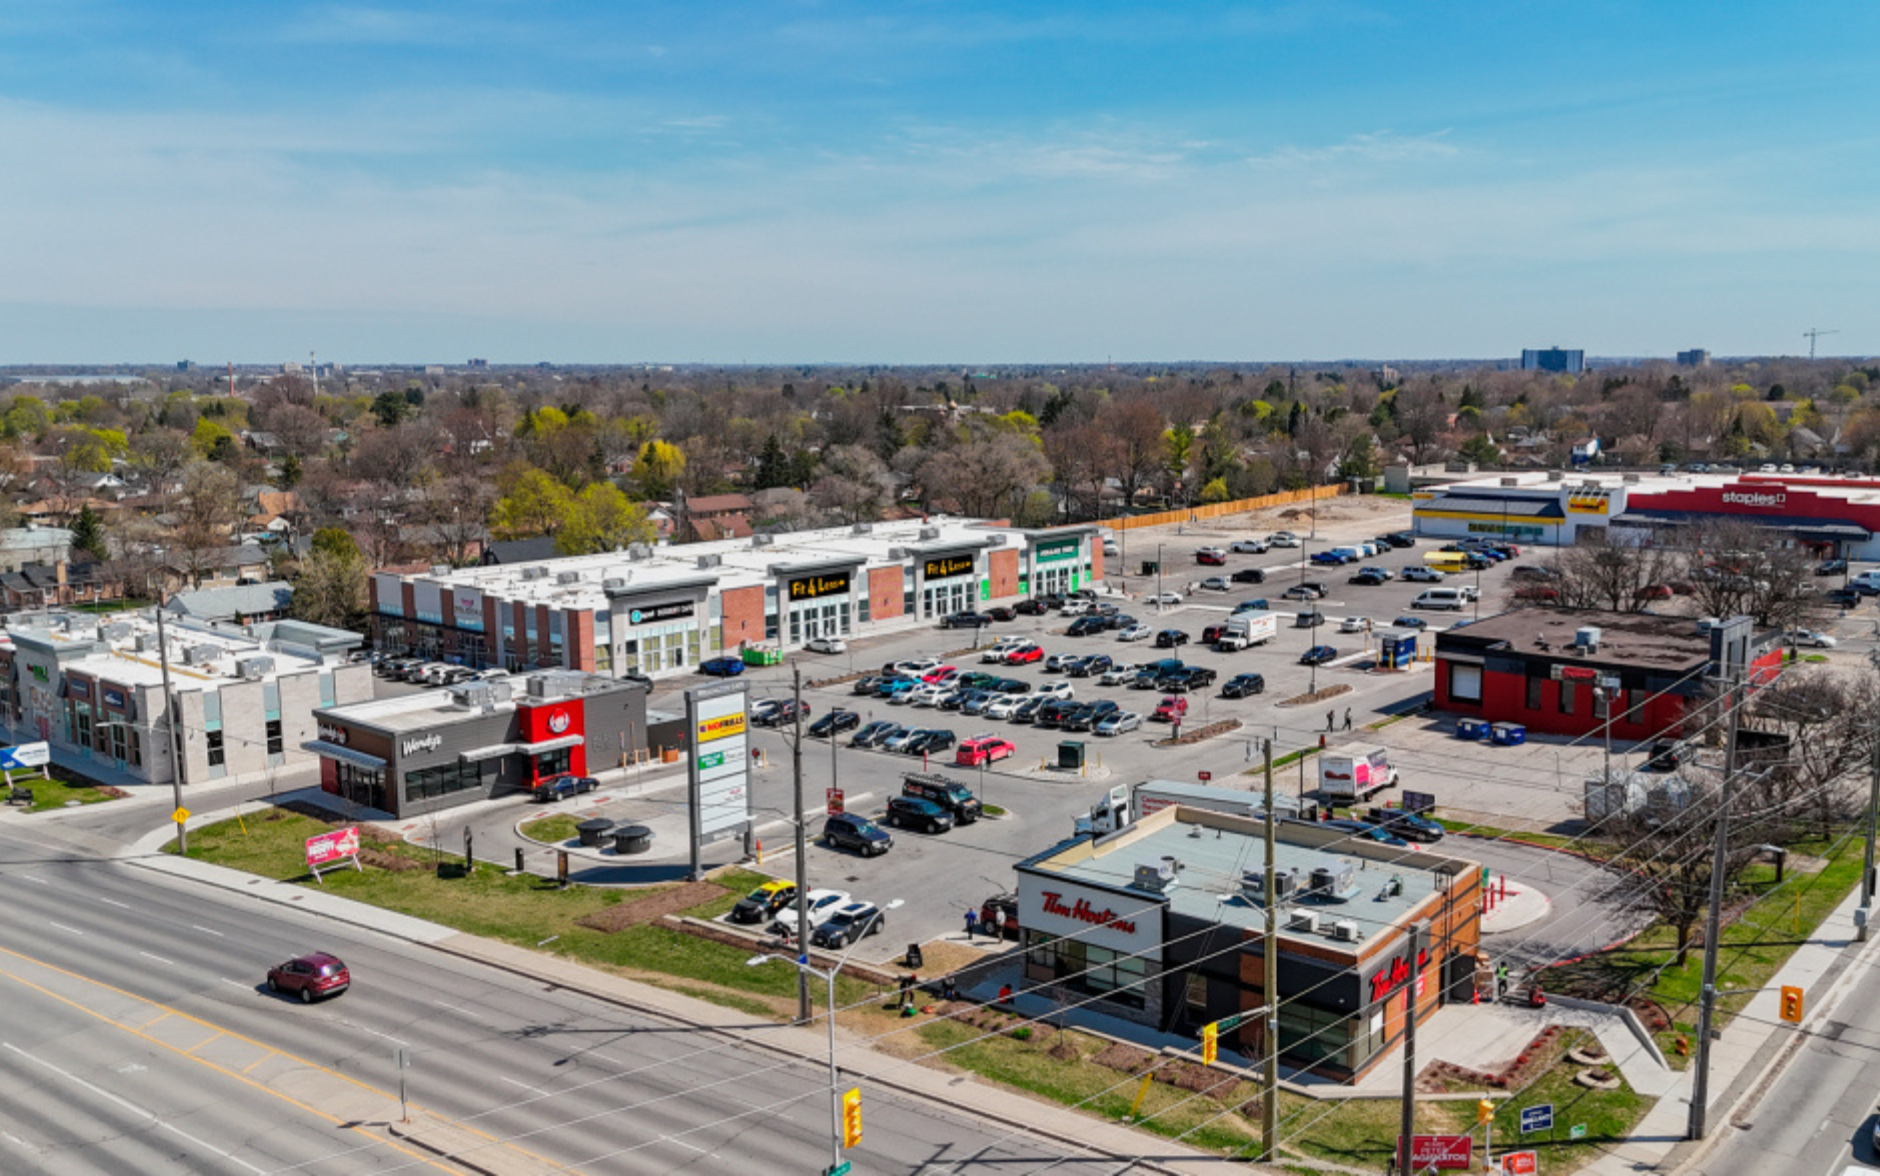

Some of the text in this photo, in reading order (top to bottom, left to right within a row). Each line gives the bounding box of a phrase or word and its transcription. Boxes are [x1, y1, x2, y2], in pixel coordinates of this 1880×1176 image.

[1722, 491, 1776, 506] staples
[939, 559, 947, 576] 4
[792, 577, 839, 597] Fit 4 Less
[402, 733, 443, 757] Wendy's
[1041, 891, 1136, 934] Tim Hortons
